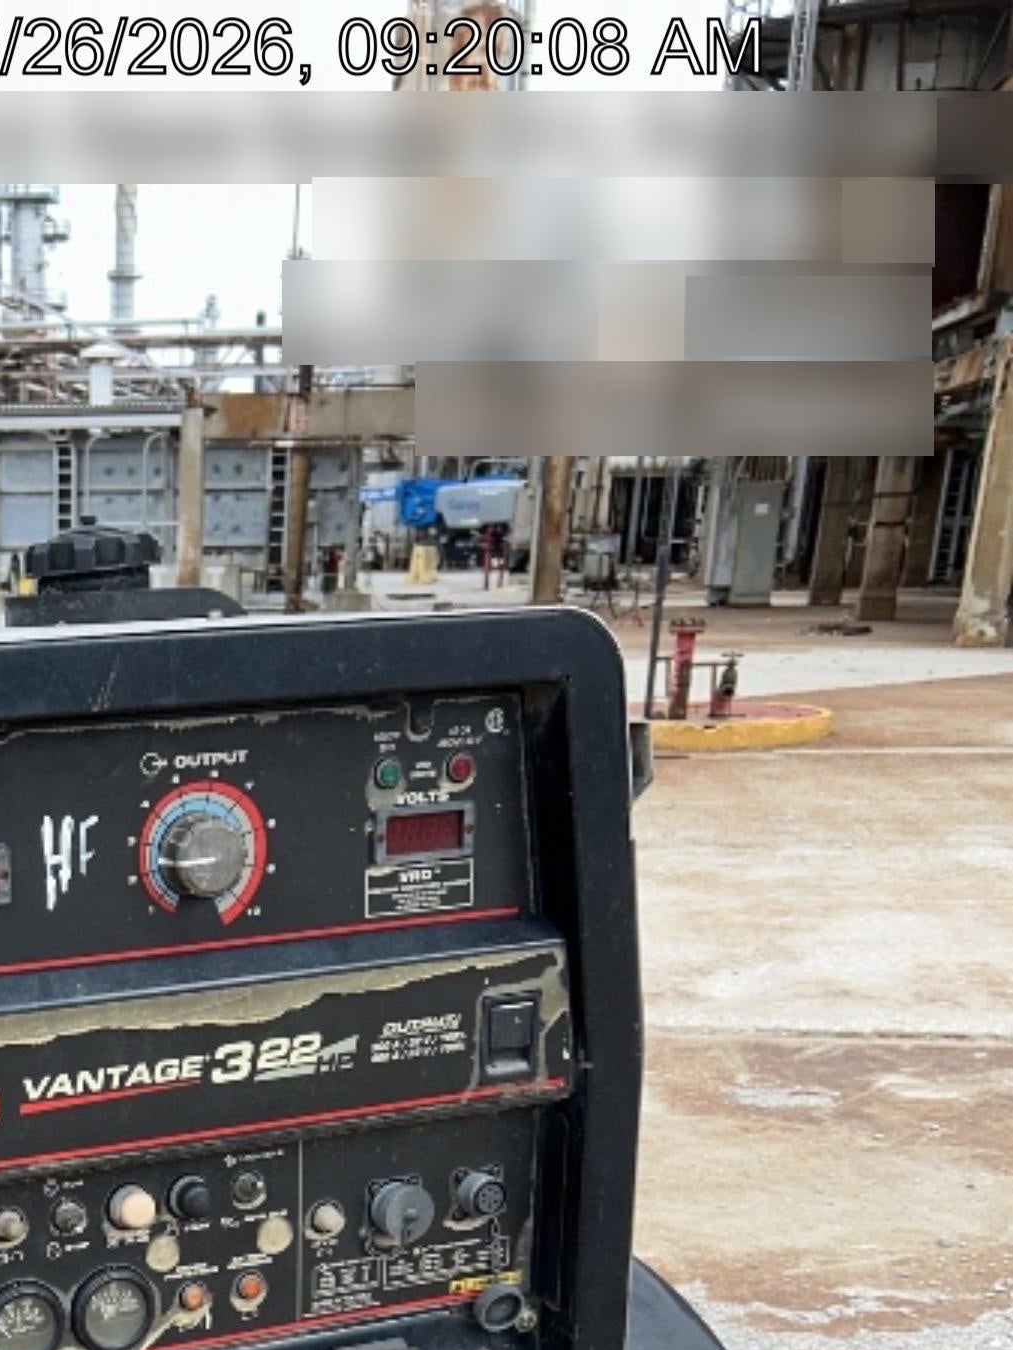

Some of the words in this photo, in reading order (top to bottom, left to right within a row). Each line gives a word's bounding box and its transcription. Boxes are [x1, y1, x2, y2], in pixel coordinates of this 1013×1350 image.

[174, 750, 248, 768] OUTPUT
[396, 791, 449, 804] VOLTS
[41, 815, 99, 911] HF
[22, 1055, 205, 1100] VANTAGE
[211, 1032, 322, 1084] 322
